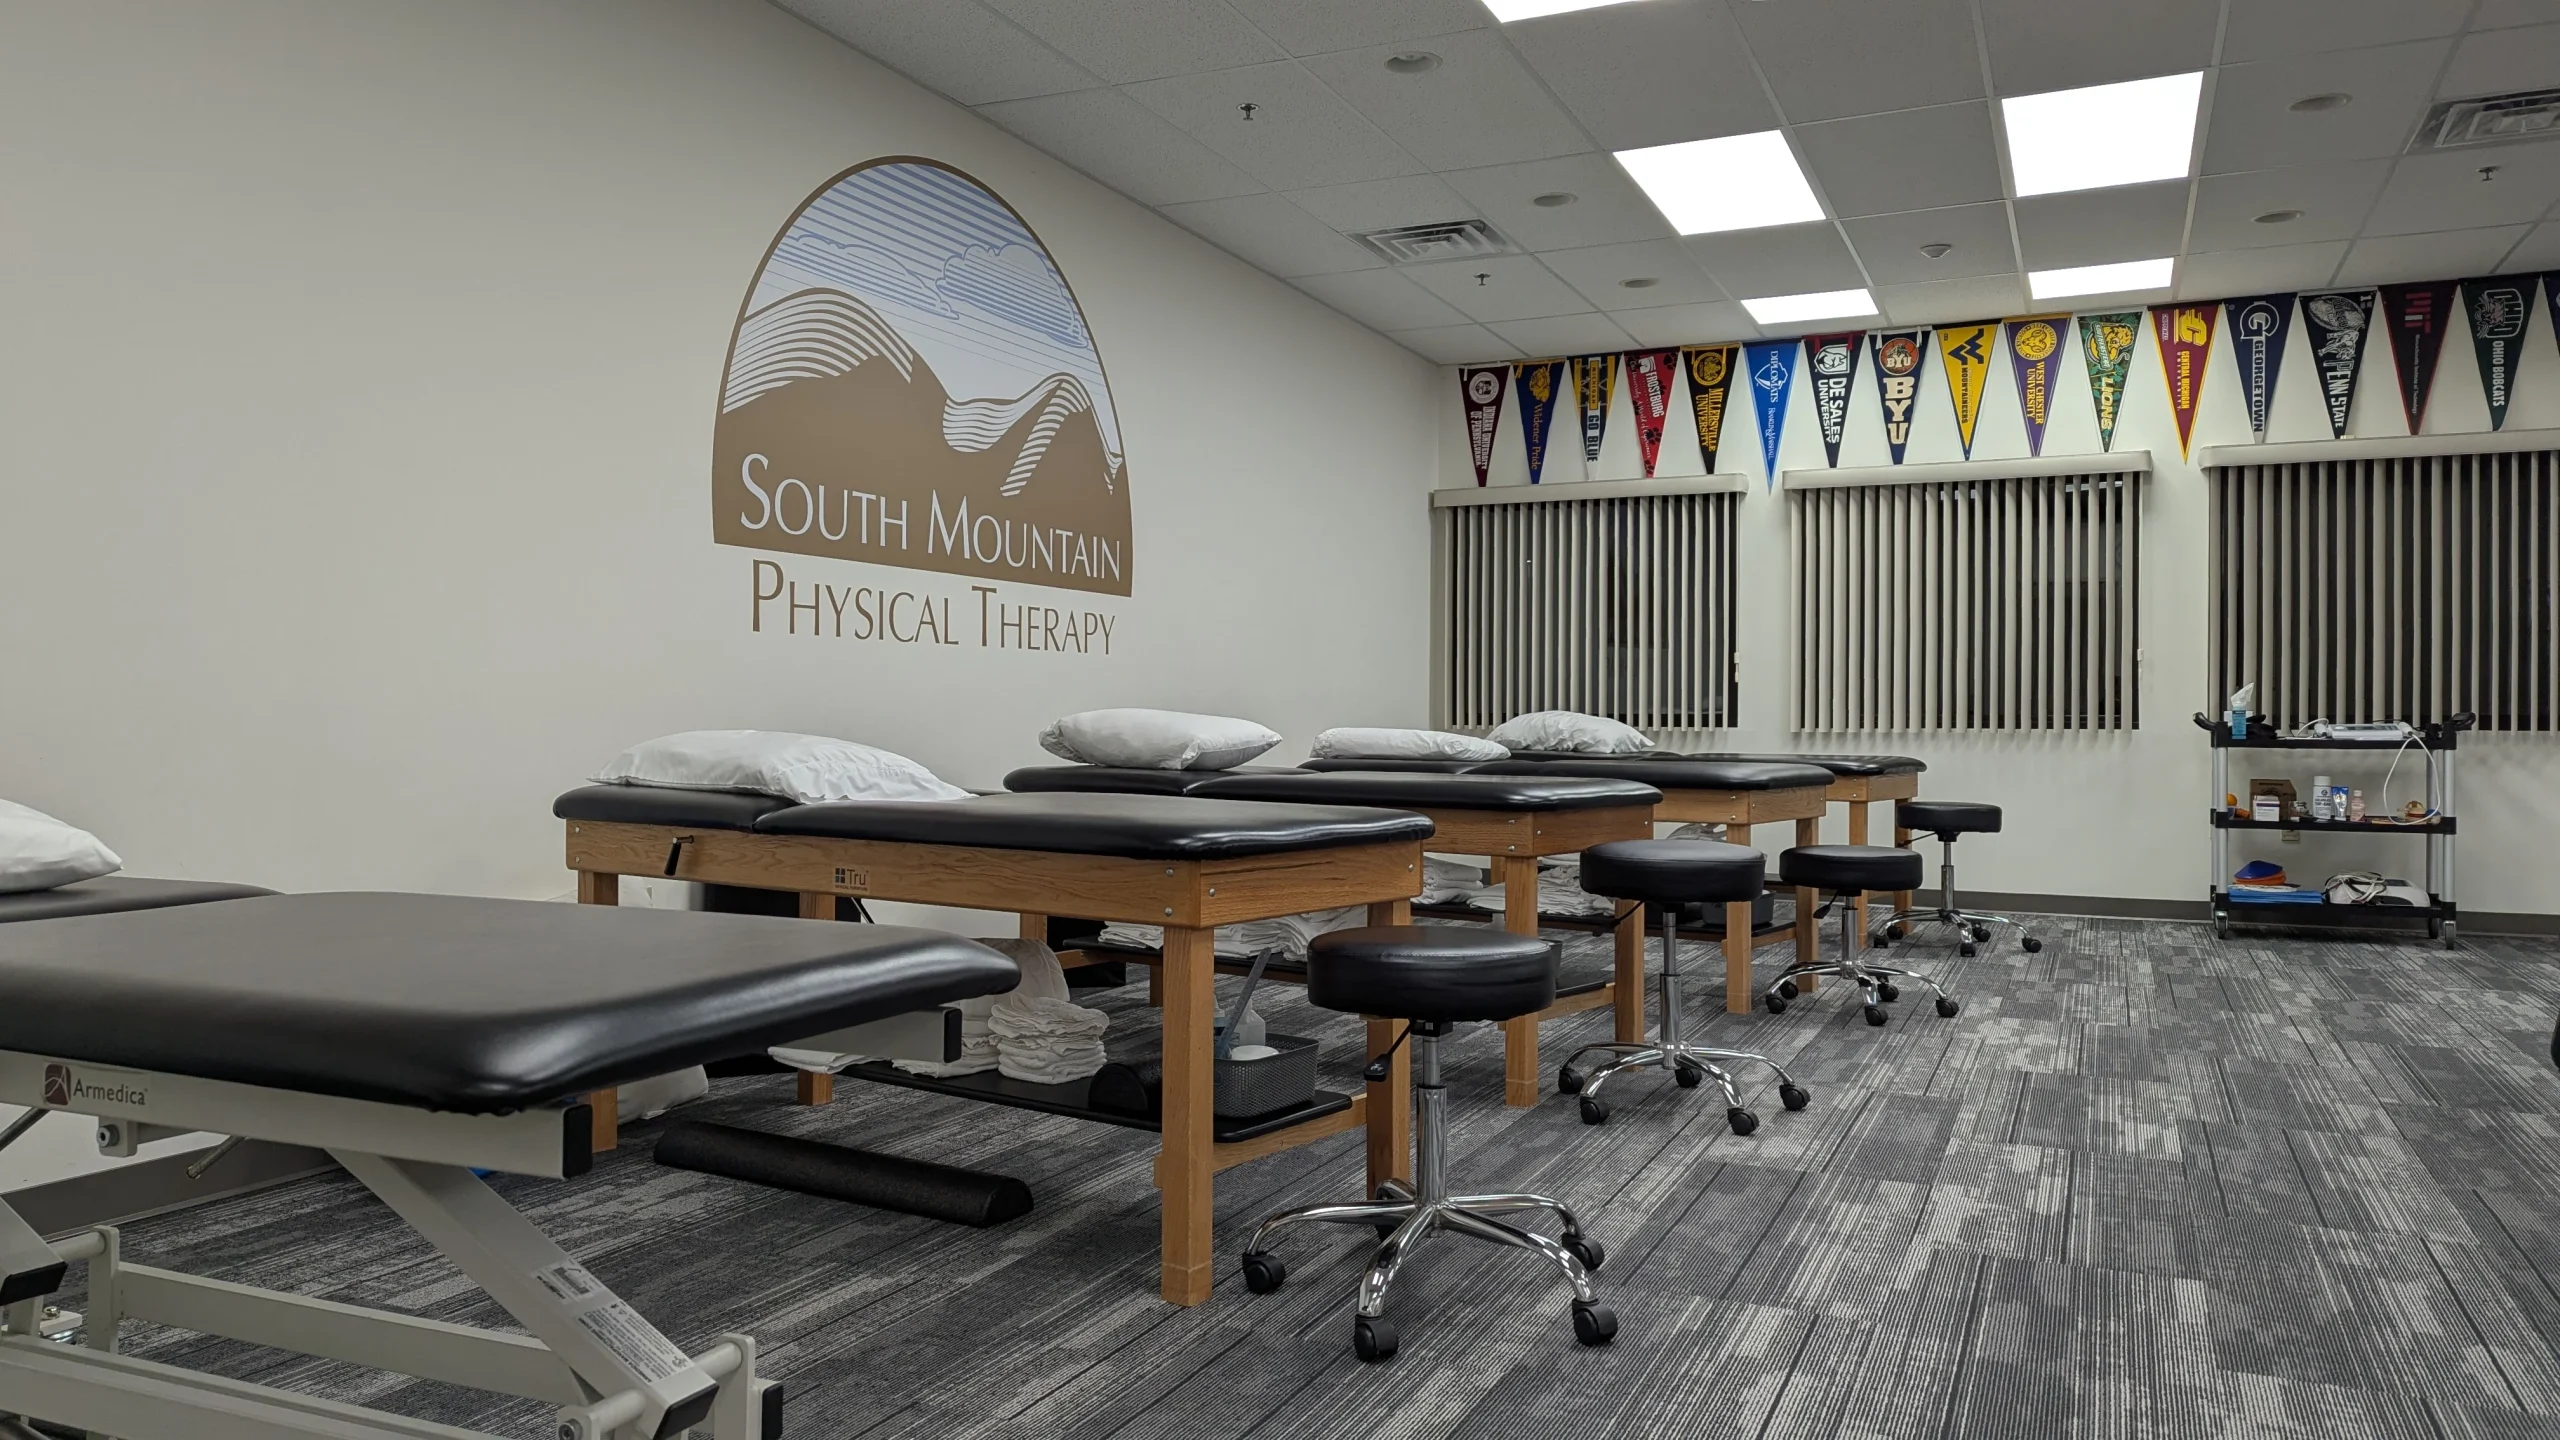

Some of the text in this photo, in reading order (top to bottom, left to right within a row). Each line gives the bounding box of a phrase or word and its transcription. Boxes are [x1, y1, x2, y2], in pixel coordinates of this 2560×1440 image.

[1770, 350, 1779, 403] DIPLOMATS
[1886, 354, 1912, 368] BYU
[2180, 350, 2190, 409] CENTRAL MICHIGAN
[2253, 340, 2264, 432] GEORGETOWN
[2492, 340, 2505, 407] OHIO BOBCATS
[1482, 405, 1496, 431] INDIANA
[1645, 371, 1665, 418] FROSTBURG
[1695, 393, 1709, 447] UNIVERSITY
[1708, 387, 1724, 452] MILLERSVILLE
[1818, 379, 1831, 444] UNIVERSITY
[2027, 368, 2036, 419] UNIVERSITY
[2035, 361, 2045, 425] WEST CHESTER
[2101, 376, 2113, 430] LIONS
[2323, 360, 2354, 428] PENN STATE
[1470, 410, 1482, 467] OF PENNSYLVANIA
[1481, 432, 1492, 470] UNIVERSITY
[1530, 403, 1543, 470] Widener Pride
[1586, 414, 1599, 462] GO BLUE
[740, 453, 1121, 582] SOUTH MOUNTAIN
[751, 558, 1116, 656] PHYSICAL THERAPY
[846, 868, 868, 886] Tru
[73, 1078, 146, 1106] Armedica
